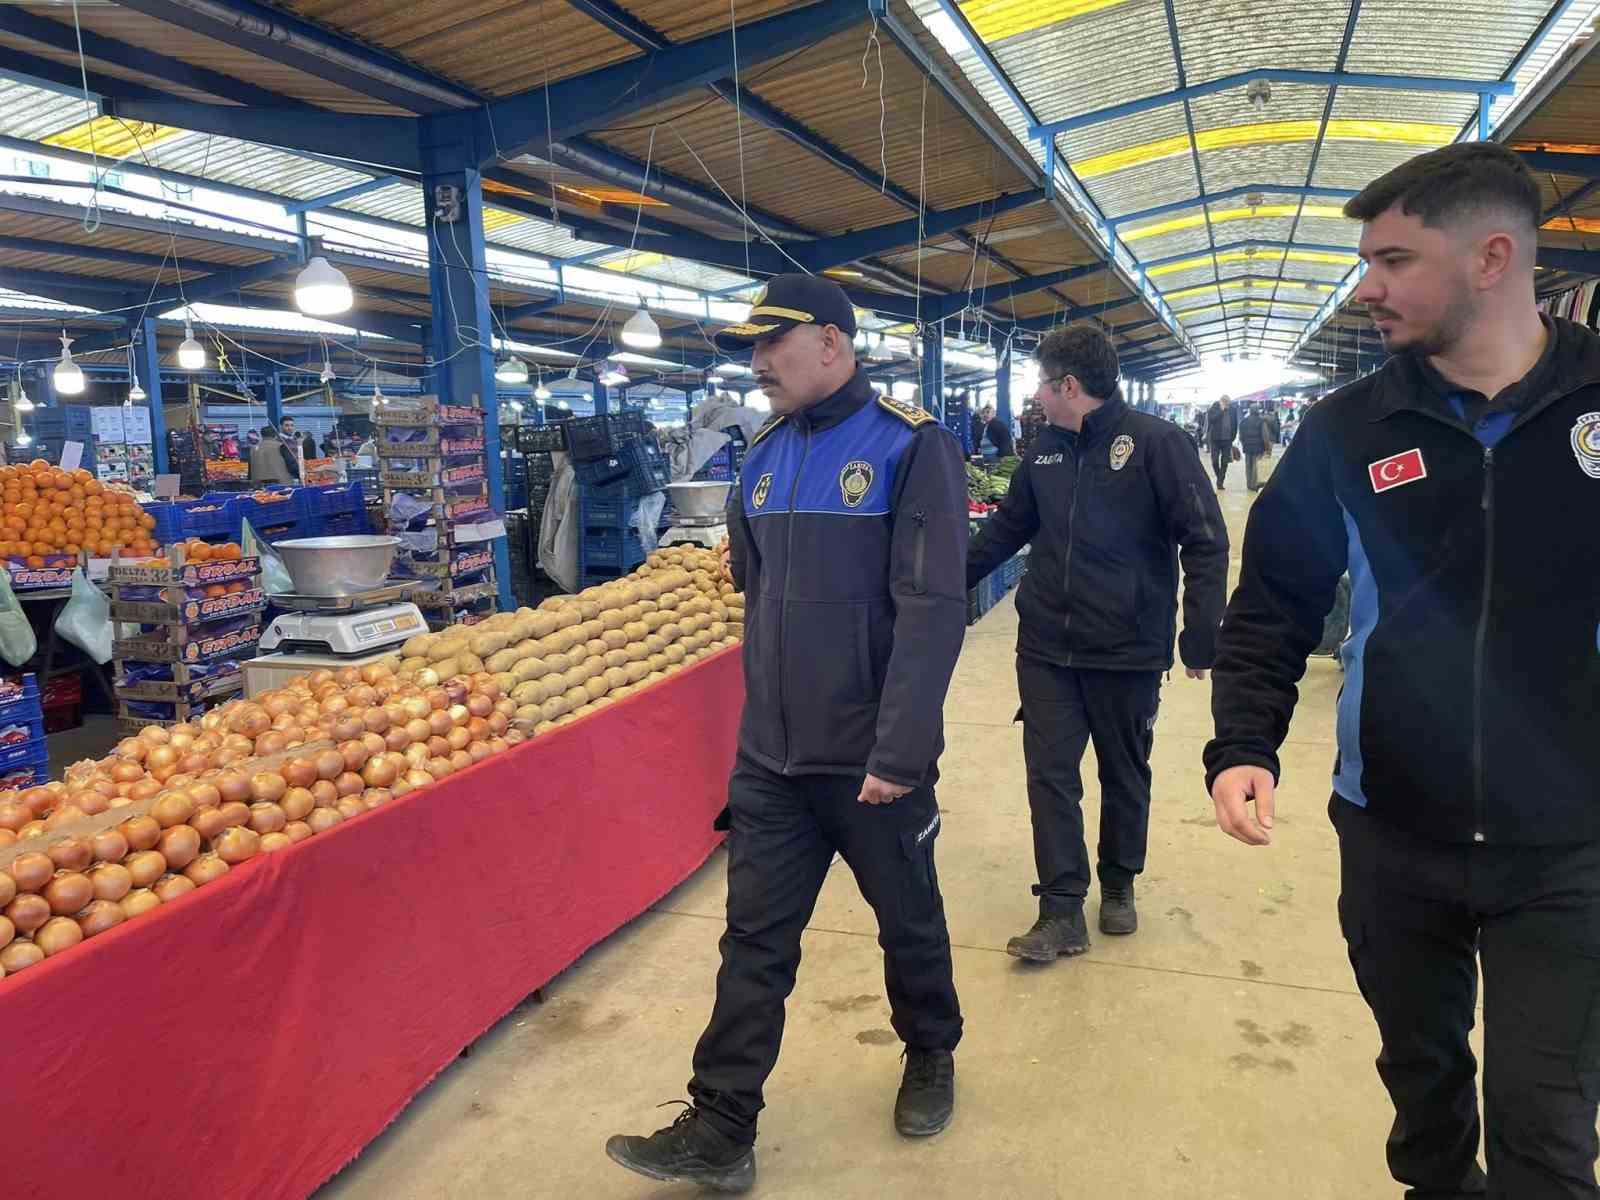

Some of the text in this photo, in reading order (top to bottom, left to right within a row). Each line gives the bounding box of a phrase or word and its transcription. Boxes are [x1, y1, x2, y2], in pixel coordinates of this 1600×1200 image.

[15, 568, 72, 583] ERDA
[199, 560, 257, 579] ERDAL
[202, 591, 263, 614] ERDAL
[202, 627, 258, 654] ERDAL
